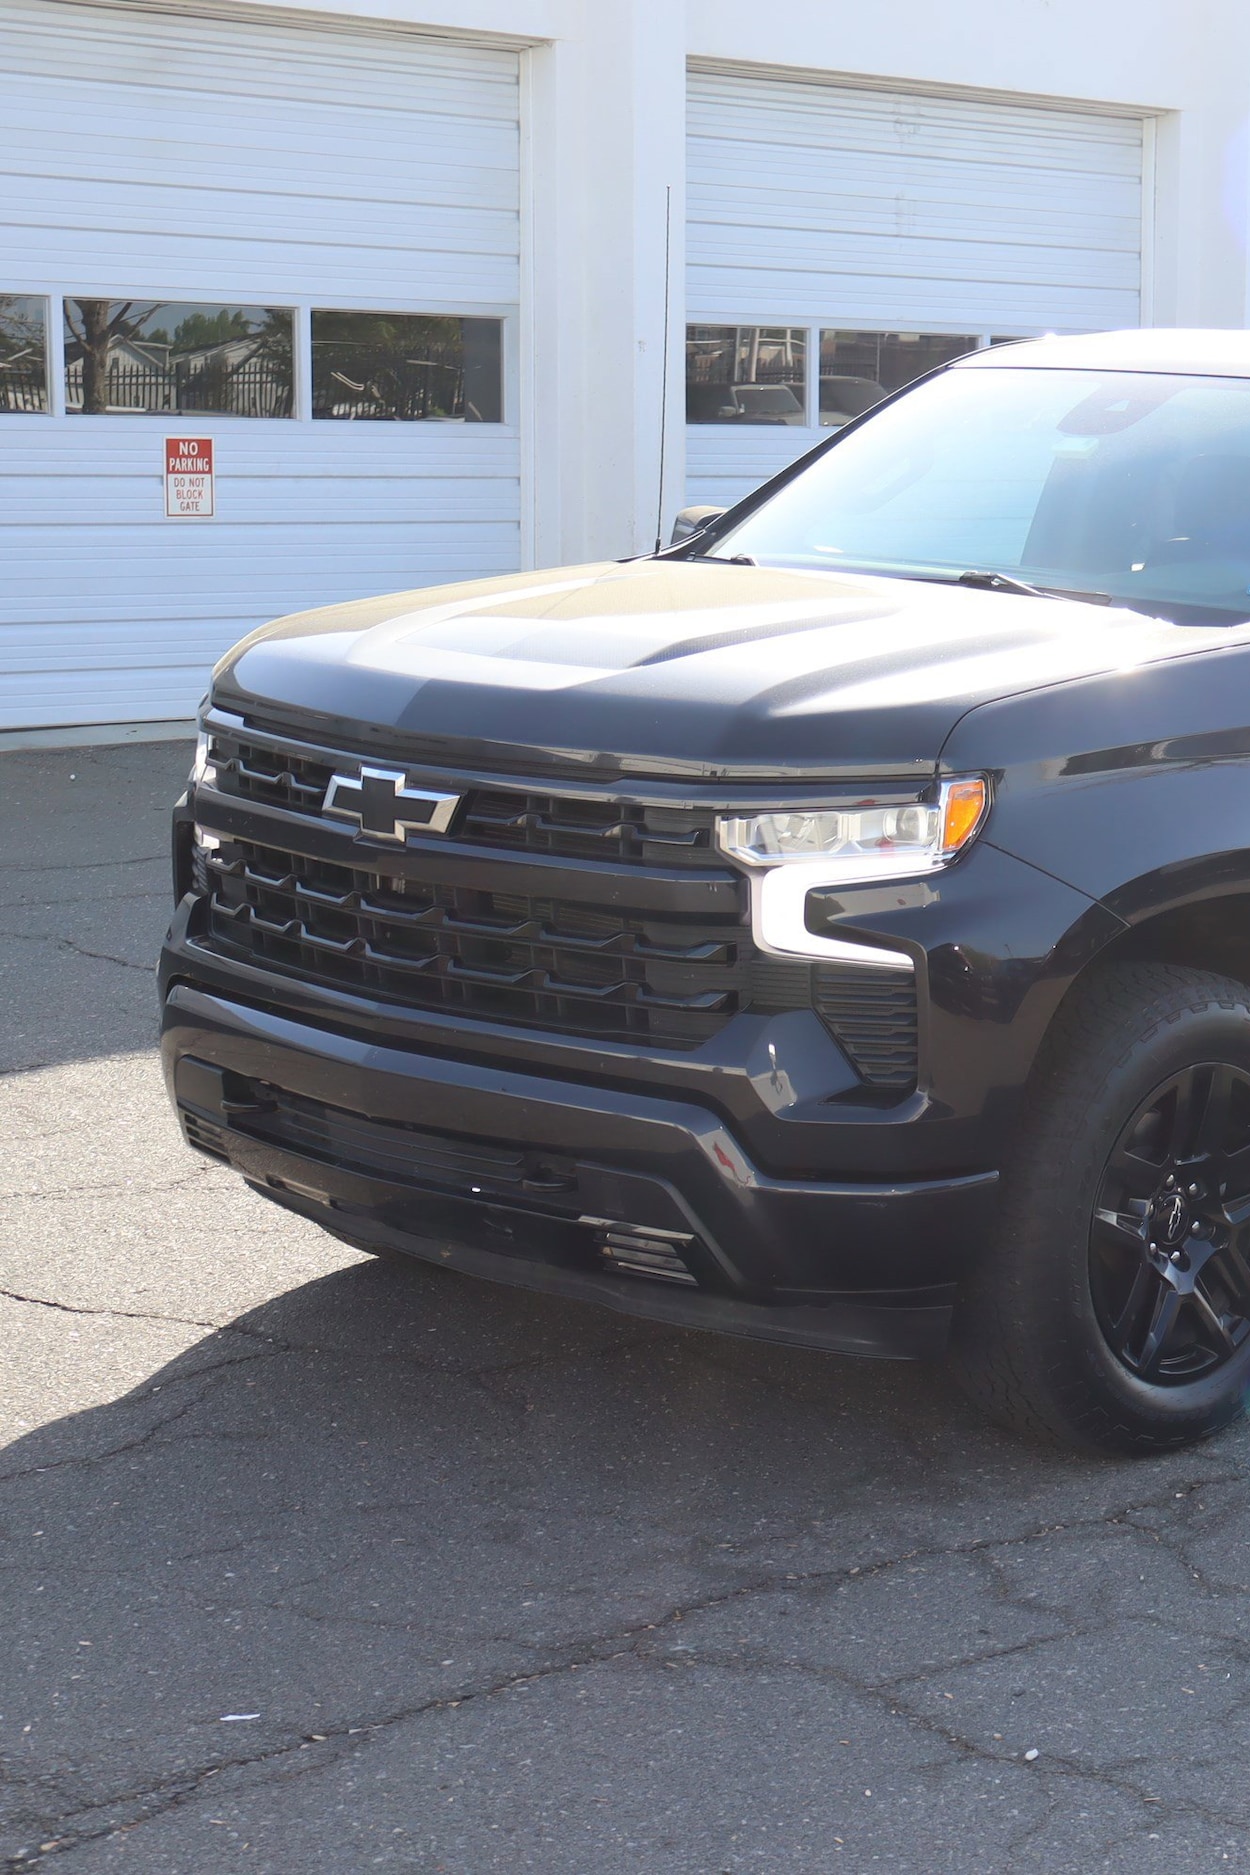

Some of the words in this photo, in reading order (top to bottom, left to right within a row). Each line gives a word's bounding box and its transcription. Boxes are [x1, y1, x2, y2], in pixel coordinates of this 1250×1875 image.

[179, 441, 199, 456] NO
[169, 457, 210, 472] PARKING
[174, 477, 186, 488] DO
[189, 477, 205, 488] NOT
[176, 489, 204, 500] BLOCK
[180, 501, 200, 512] GATE
